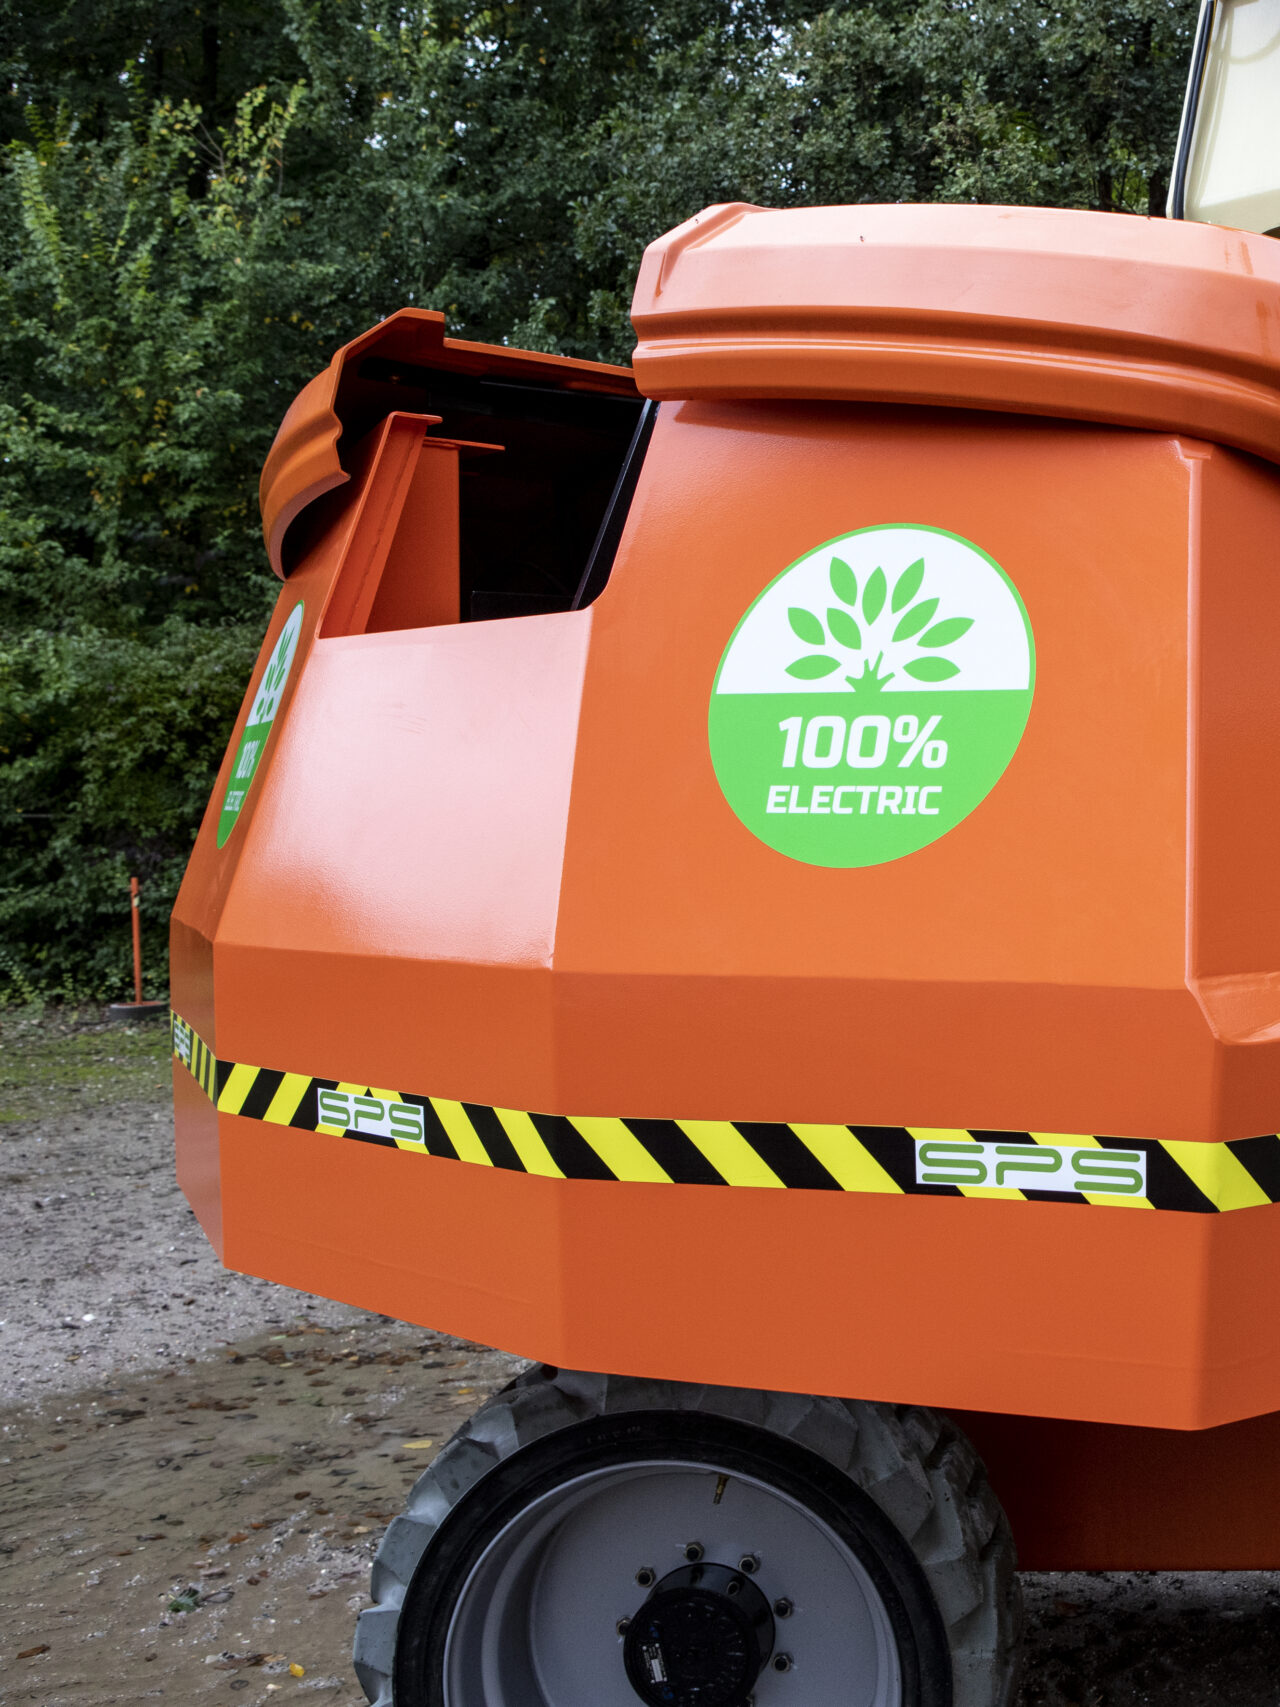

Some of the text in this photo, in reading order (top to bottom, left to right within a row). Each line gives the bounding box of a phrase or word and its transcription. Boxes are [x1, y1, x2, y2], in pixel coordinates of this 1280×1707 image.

[778, 714, 949, 769] 100%
[766, 785, 943, 815] ELECTRIC
[319, 1090, 423, 1142] SPS
[918, 1142, 1144, 1194] SPS
